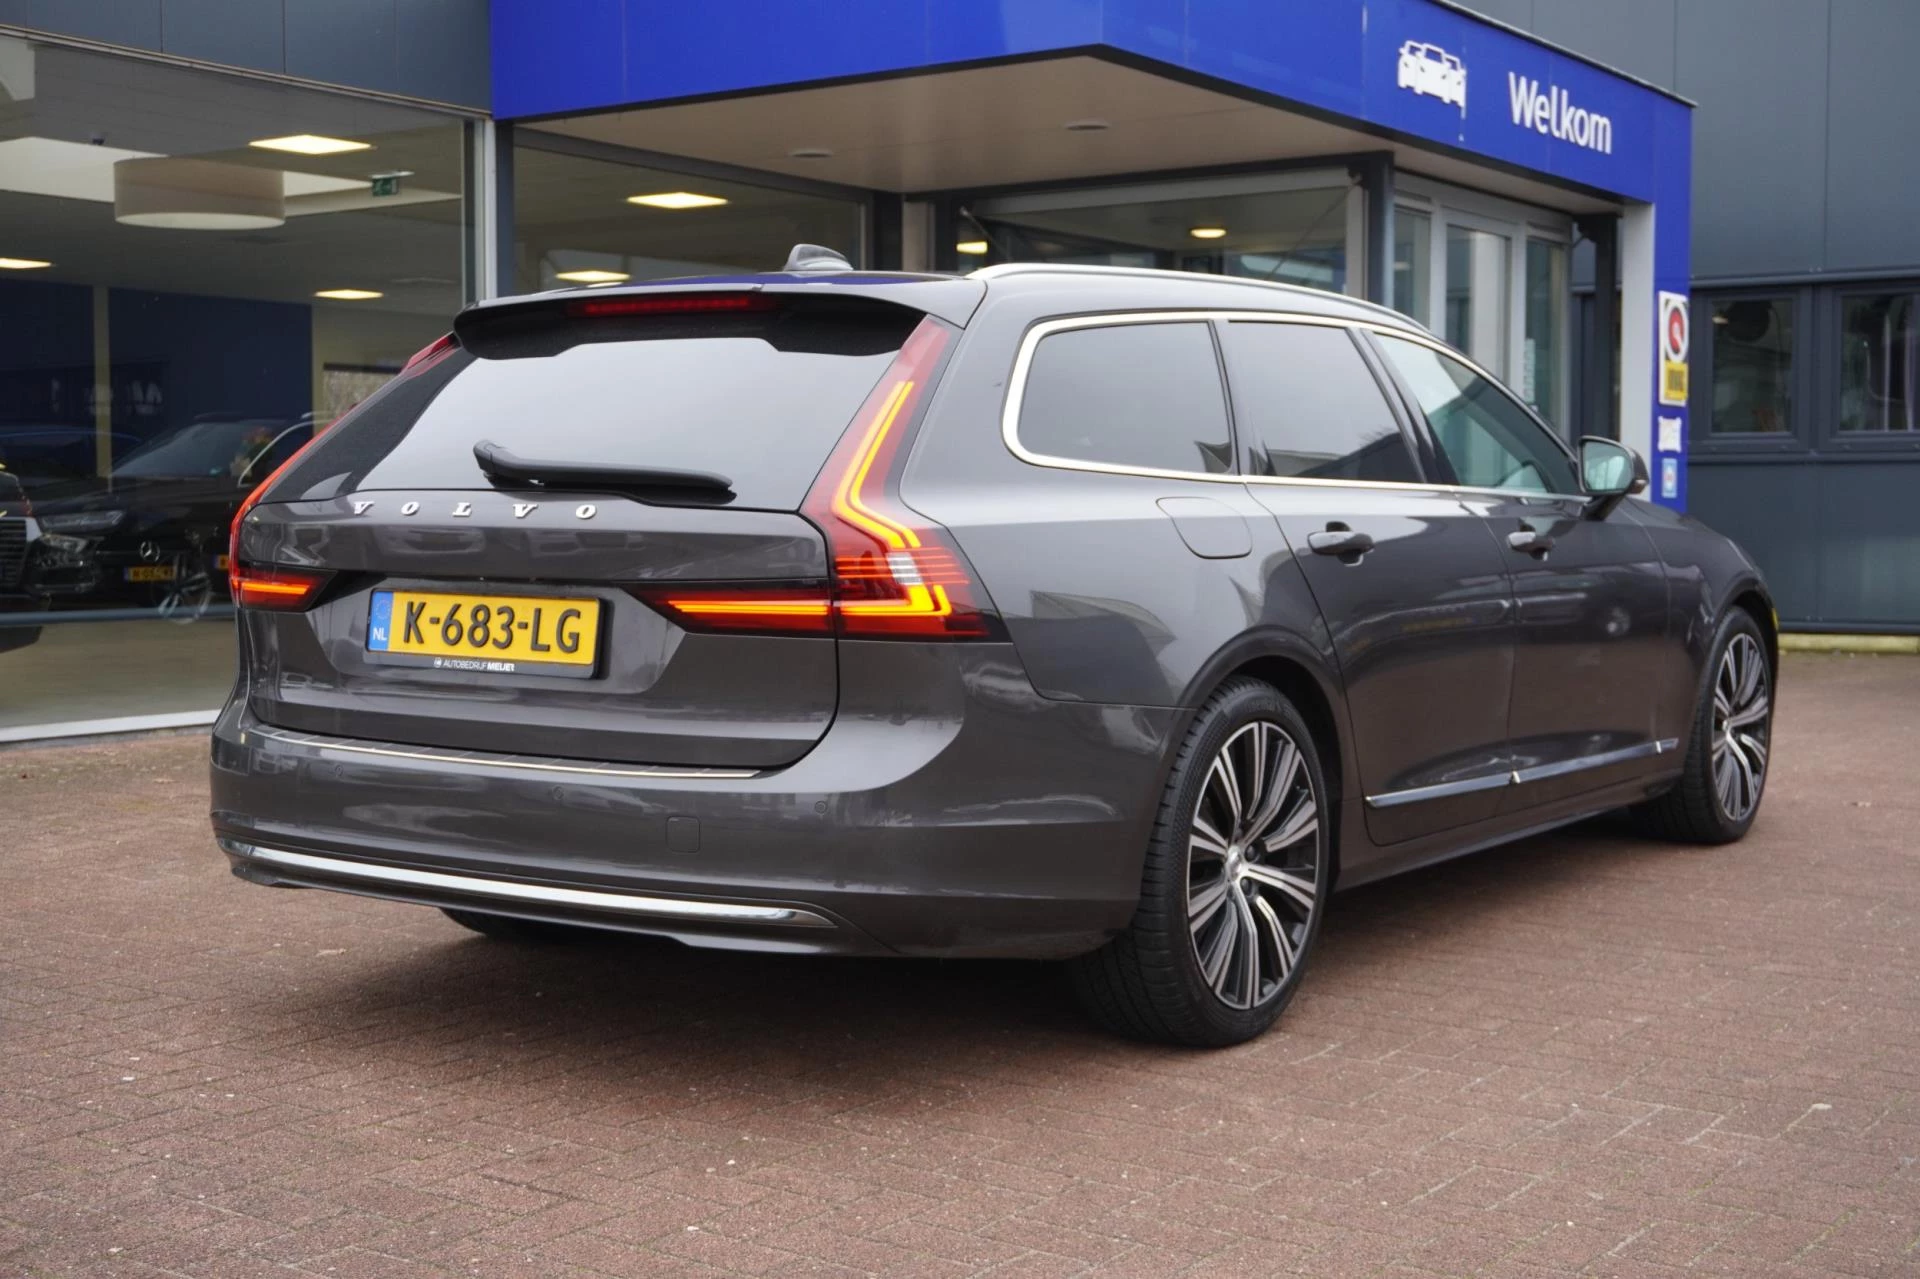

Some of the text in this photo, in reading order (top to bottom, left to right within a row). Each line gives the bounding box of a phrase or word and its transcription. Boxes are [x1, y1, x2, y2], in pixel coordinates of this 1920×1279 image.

[1508, 71, 1612, 155] Welkom
[353, 501, 598, 519] VOLVO
[373, 627, 387, 641] NL
[403, 600, 581, 654] K-683-LG
